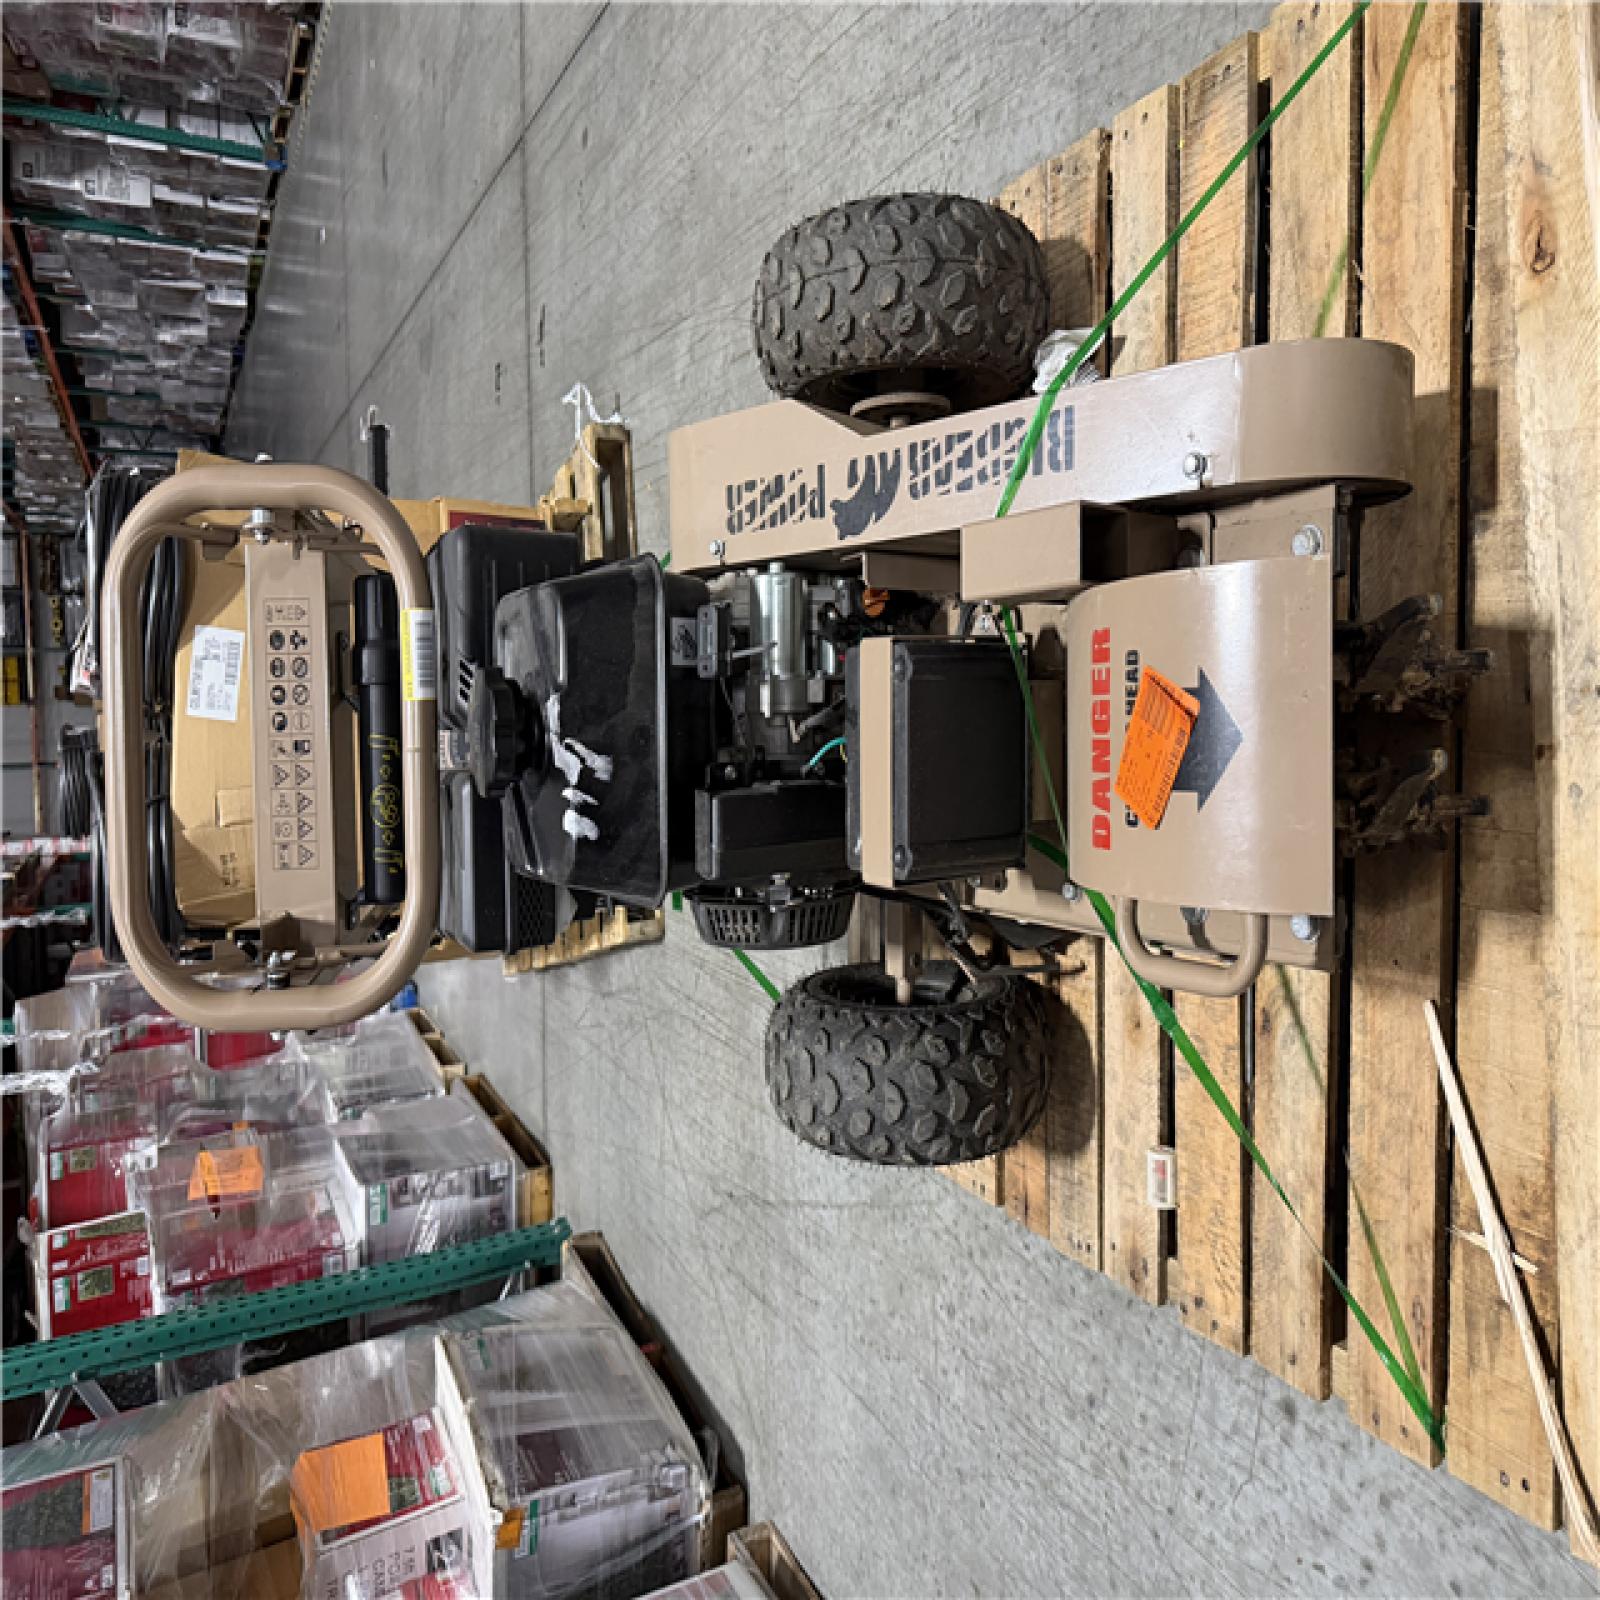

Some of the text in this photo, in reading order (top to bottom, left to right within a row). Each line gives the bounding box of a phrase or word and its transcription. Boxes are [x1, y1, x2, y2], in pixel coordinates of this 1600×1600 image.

[725, 463, 826, 535] POWER
[1125, 649, 1139, 716] HEAD
[1092, 627, 1111, 850] DANGER
